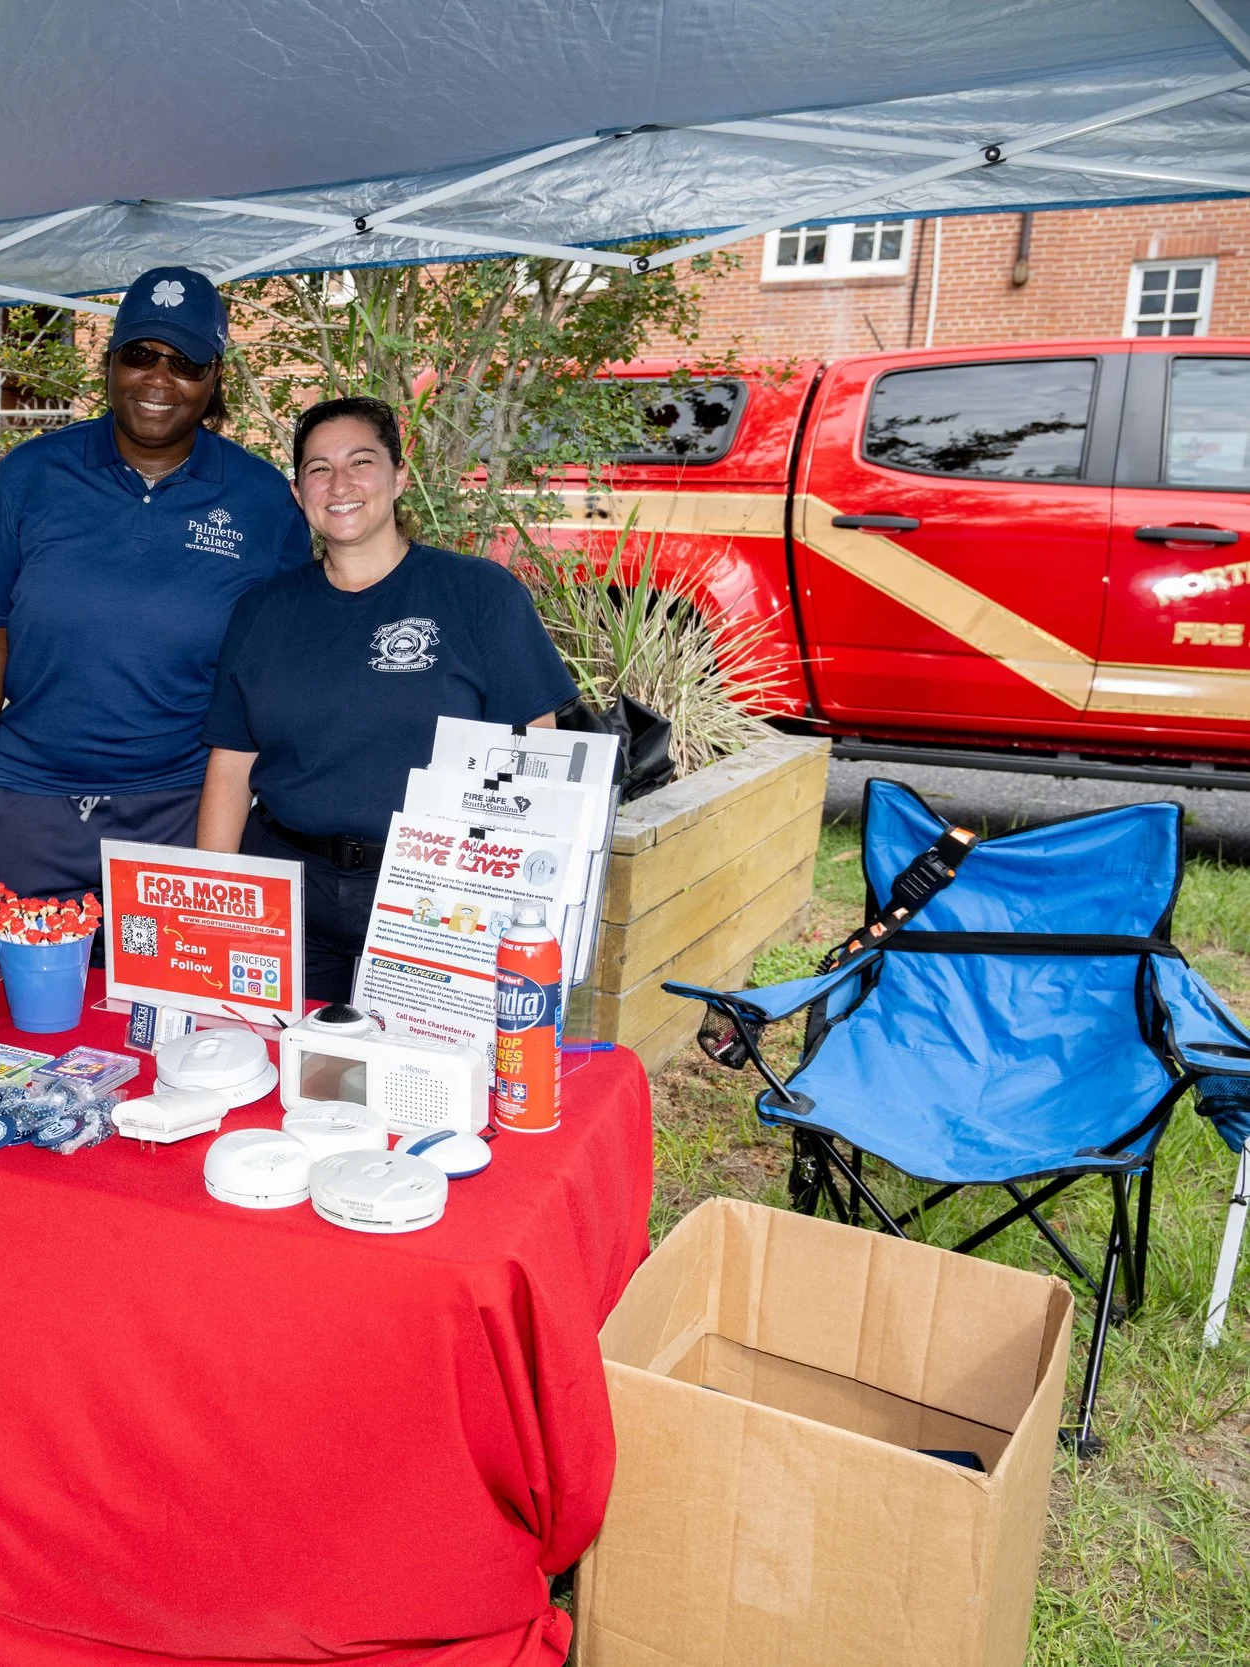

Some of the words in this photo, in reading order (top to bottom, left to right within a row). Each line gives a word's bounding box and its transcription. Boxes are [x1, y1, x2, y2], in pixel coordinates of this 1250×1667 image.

[187, 520, 243, 542] Palmetto
[185, 543, 216, 552] OUTREACH
[194, 533, 234, 550] Palace
[1172, 621, 1245, 647] FIRE
[462, 799, 484, 808] South
[463, 792, 483, 802] FIRE
[485, 796, 506, 804] AFE
[399, 826, 456, 848] SMOKE
[459, 840, 523, 860] ALARMS
[396, 842, 450, 866] SAVE
[456, 854, 520, 878] LIVES
[144, 876, 186, 896] FOR
[193, 882, 256, 904] MORE
[414, 884, 436, 892] sleeping.
[144, 891, 256, 918] INFORMATION
[183, 916, 280, 935] WWW.NORTHCHARLESTON.ORG
[175, 940, 206, 956] Scan
[170, 958, 212, 974] Follow
[232, 954, 278, 968] @NCFDSC
[375, 960, 400, 970] RENTAL
[403, 966, 446, 981] PROPERTIES
[504, 975, 521, 984] Alert
[497, 988, 539, 1015] ndra
[135, 1006, 146, 1041] NORTH
[408, 1016, 426, 1025] North
[428, 1021, 461, 1035] Charleston
[463, 1030, 475, 1038] Fire
[410, 1026, 447, 1041] Department
[10, 1047, 29, 1056] every
[30, 1051, 49, 1060] hero
[94, 1049, 114, 1058] every
[115, 1052, 134, 1062] hero
[405, 1064, 430, 1076] lifetone
[496, 1060, 522, 1074] AST!
